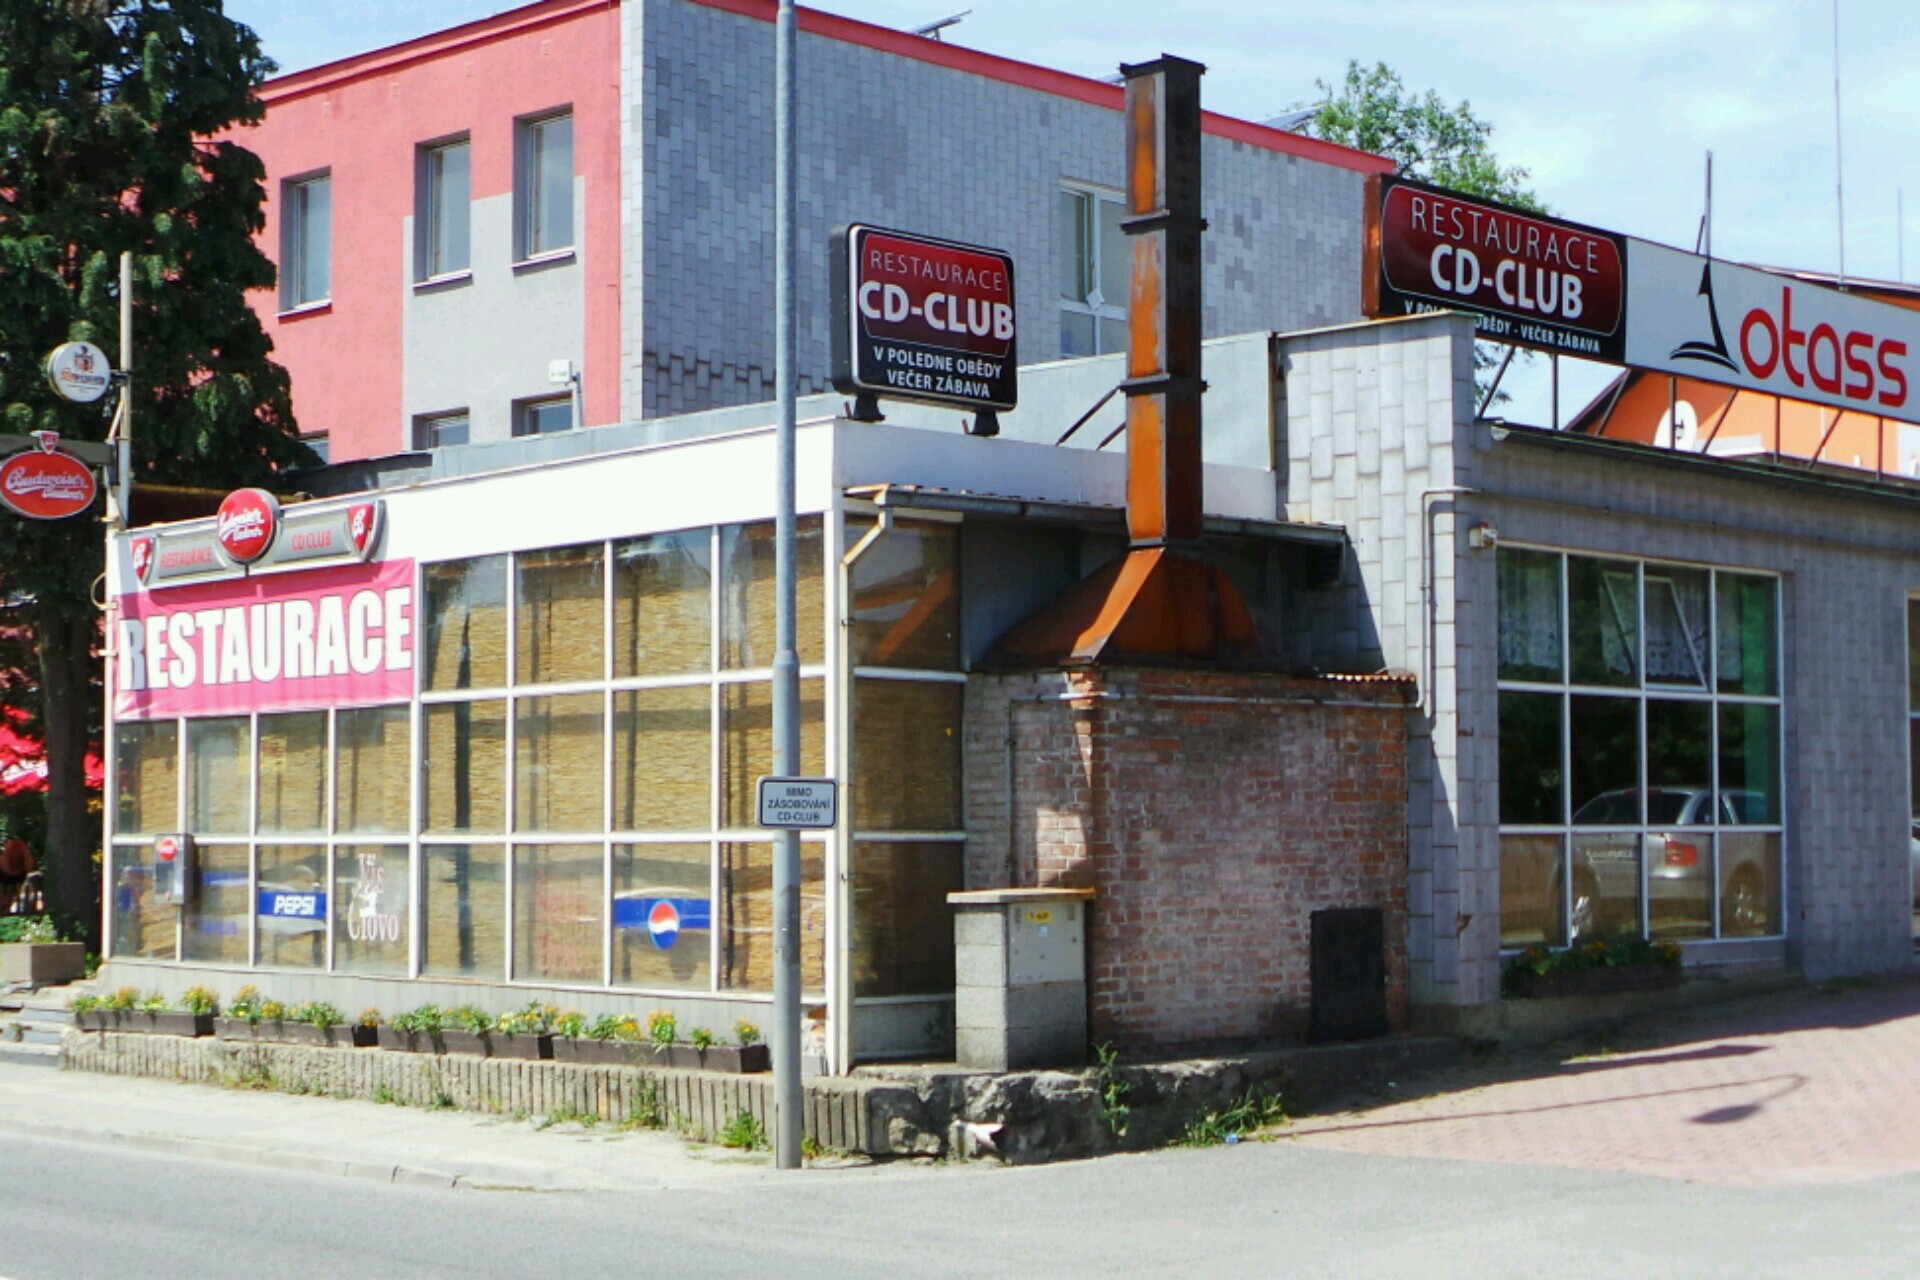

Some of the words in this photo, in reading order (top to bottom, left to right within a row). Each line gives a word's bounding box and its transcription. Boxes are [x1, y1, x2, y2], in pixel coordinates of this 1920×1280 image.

[1411, 197, 1599, 274] RESTAURACE
[870, 250, 1003, 291] RESTAURACE
[1430, 244, 1584, 319] CD-CLUB
[858, 280, 1015, 341] CD-CLUB
[1404, 300, 1413, 314] V
[1520, 324, 1555, 345] VEČER
[1558, 332, 1601, 354] ZÁBAVA
[873, 345, 884, 361] V
[888, 348, 953, 372] POLEDNE
[956, 357, 1002, 379] OBĚDY
[886, 368, 932, 390] VEČER
[935, 375, 990, 398] ZÁBAVA
[160, 547, 212, 569] RESTAURACE
[306, 530, 331, 548] CLUB
[119, 586, 412, 691] RESTAURACE
[768, 797, 831, 810] ZÁSOBOVÁNÍ
[786, 787, 813, 797] MIMO
[777, 811, 821, 822] CD-CLUB
[274, 893, 318, 916] PEPSI
